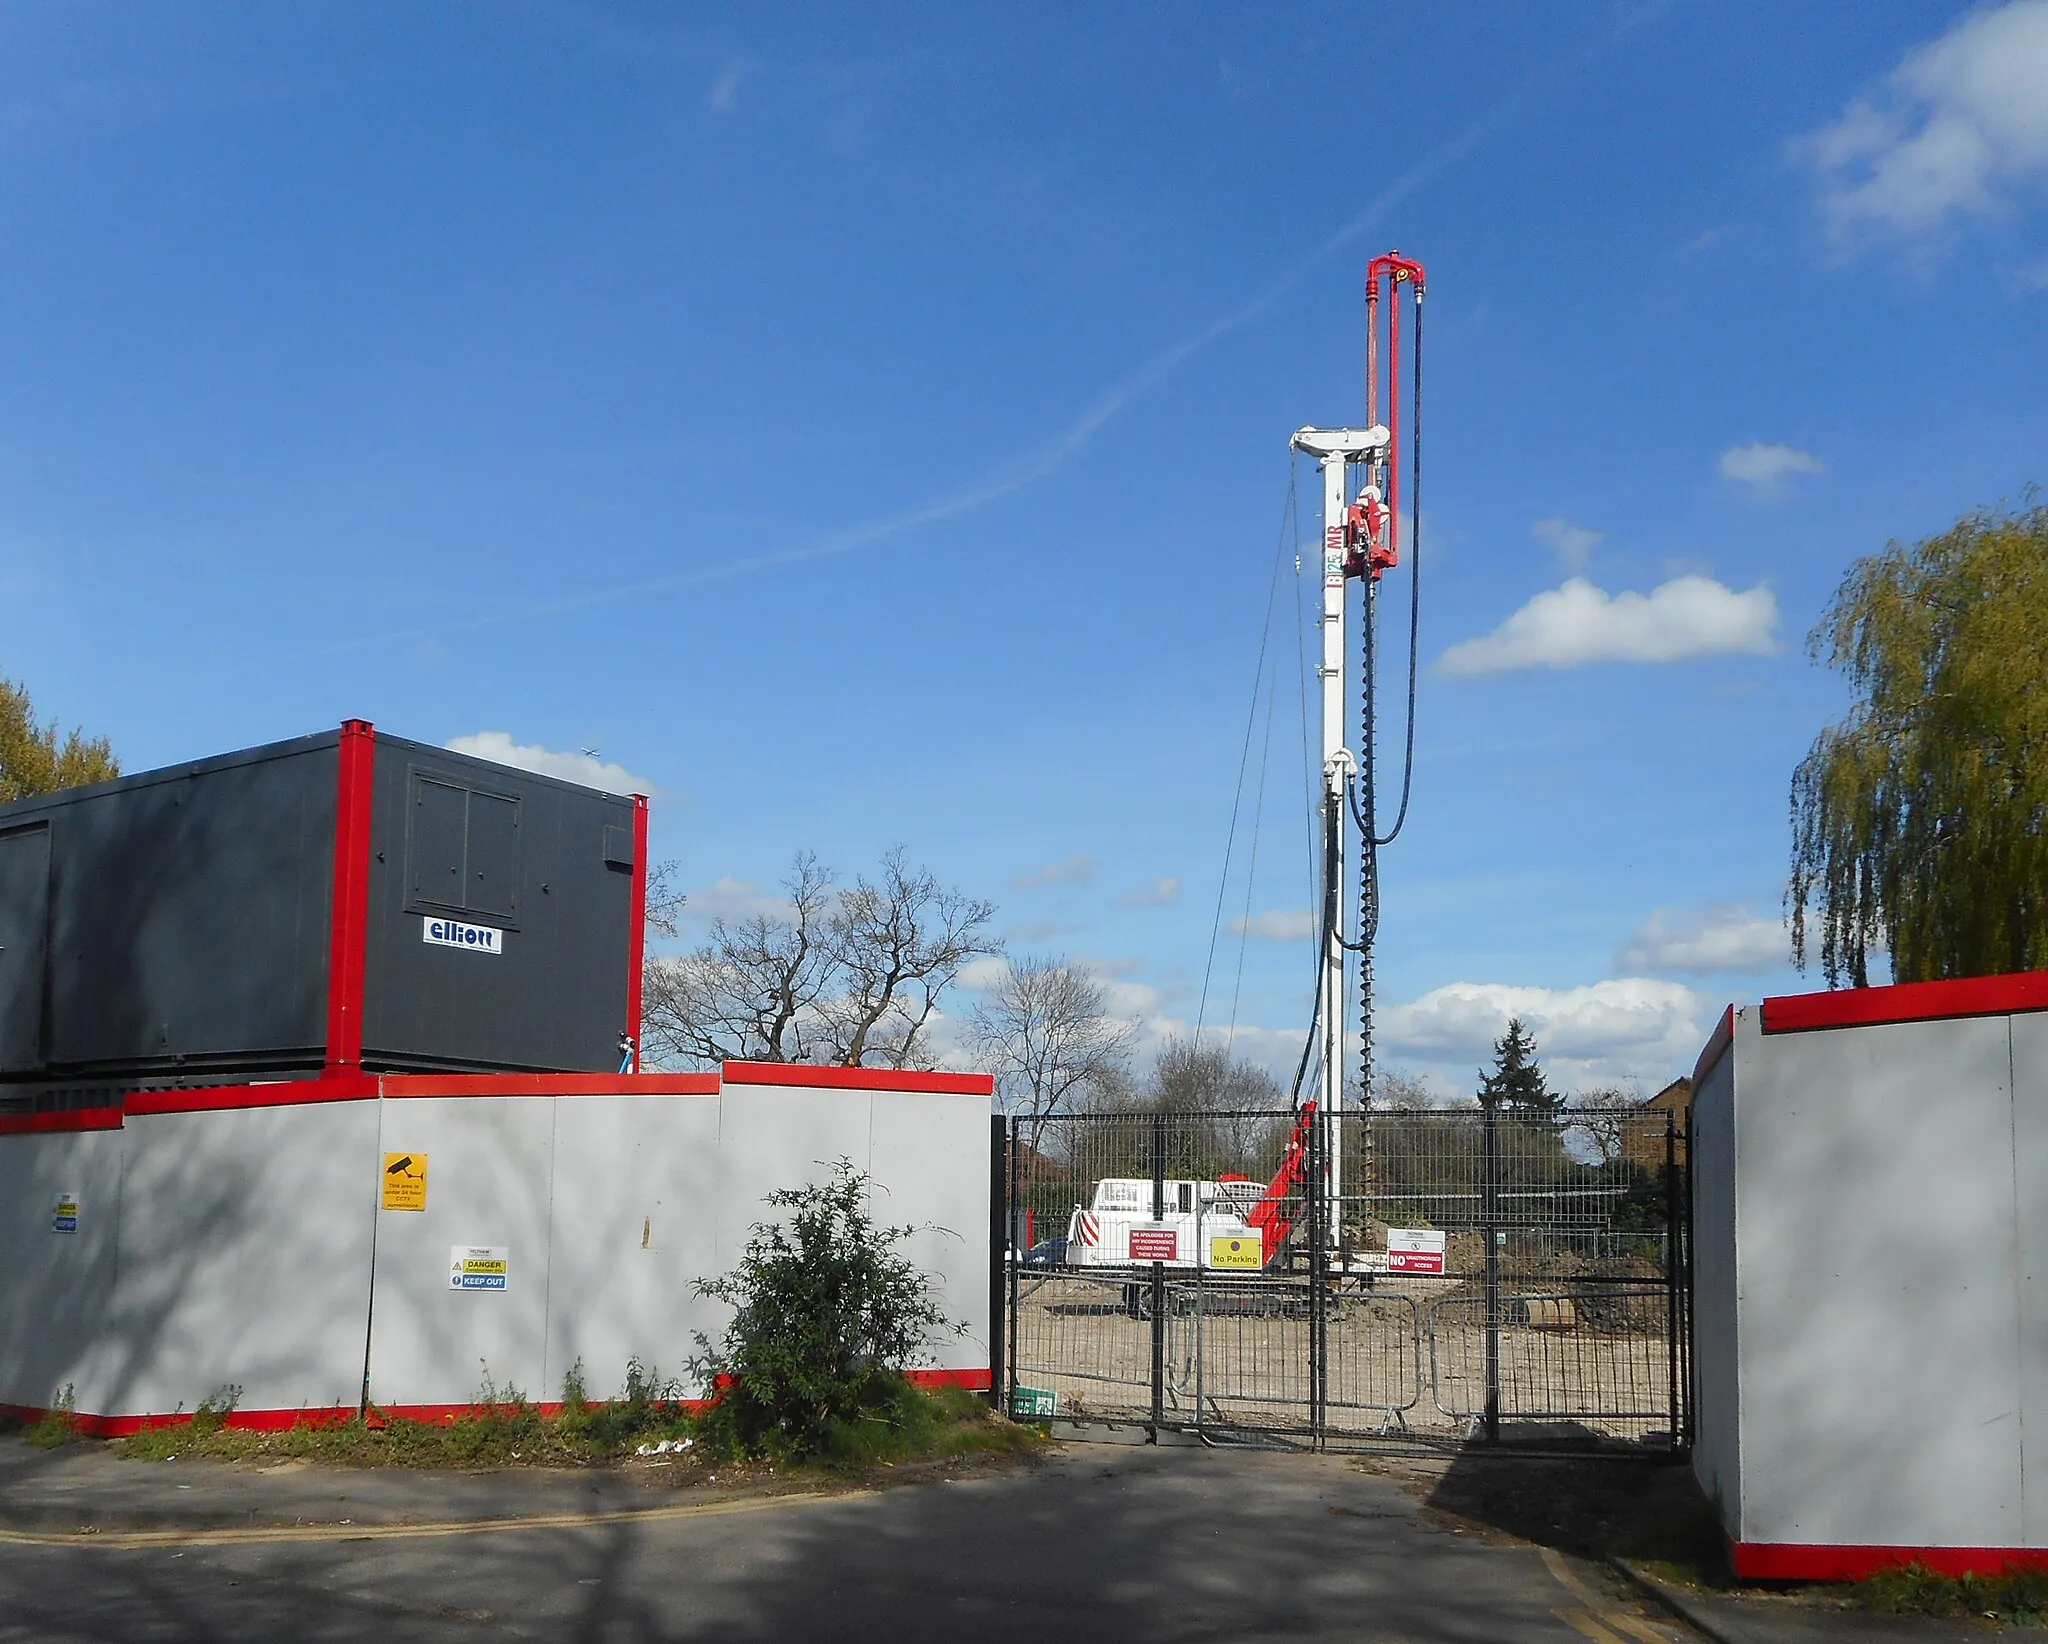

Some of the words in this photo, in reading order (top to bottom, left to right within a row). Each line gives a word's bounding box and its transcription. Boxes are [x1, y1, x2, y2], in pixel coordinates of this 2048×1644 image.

[1327, 525, 1342, 549] MR
[430, 921, 493, 947] elliott
[1213, 1255, 1225, 1263] No
[1226, 1255, 1258, 1265] Parking
[1389, 1255, 1406, 1266] NO
[464, 1277, 485, 1285] KEEP
[486, 1278, 504, 1286] OUT
